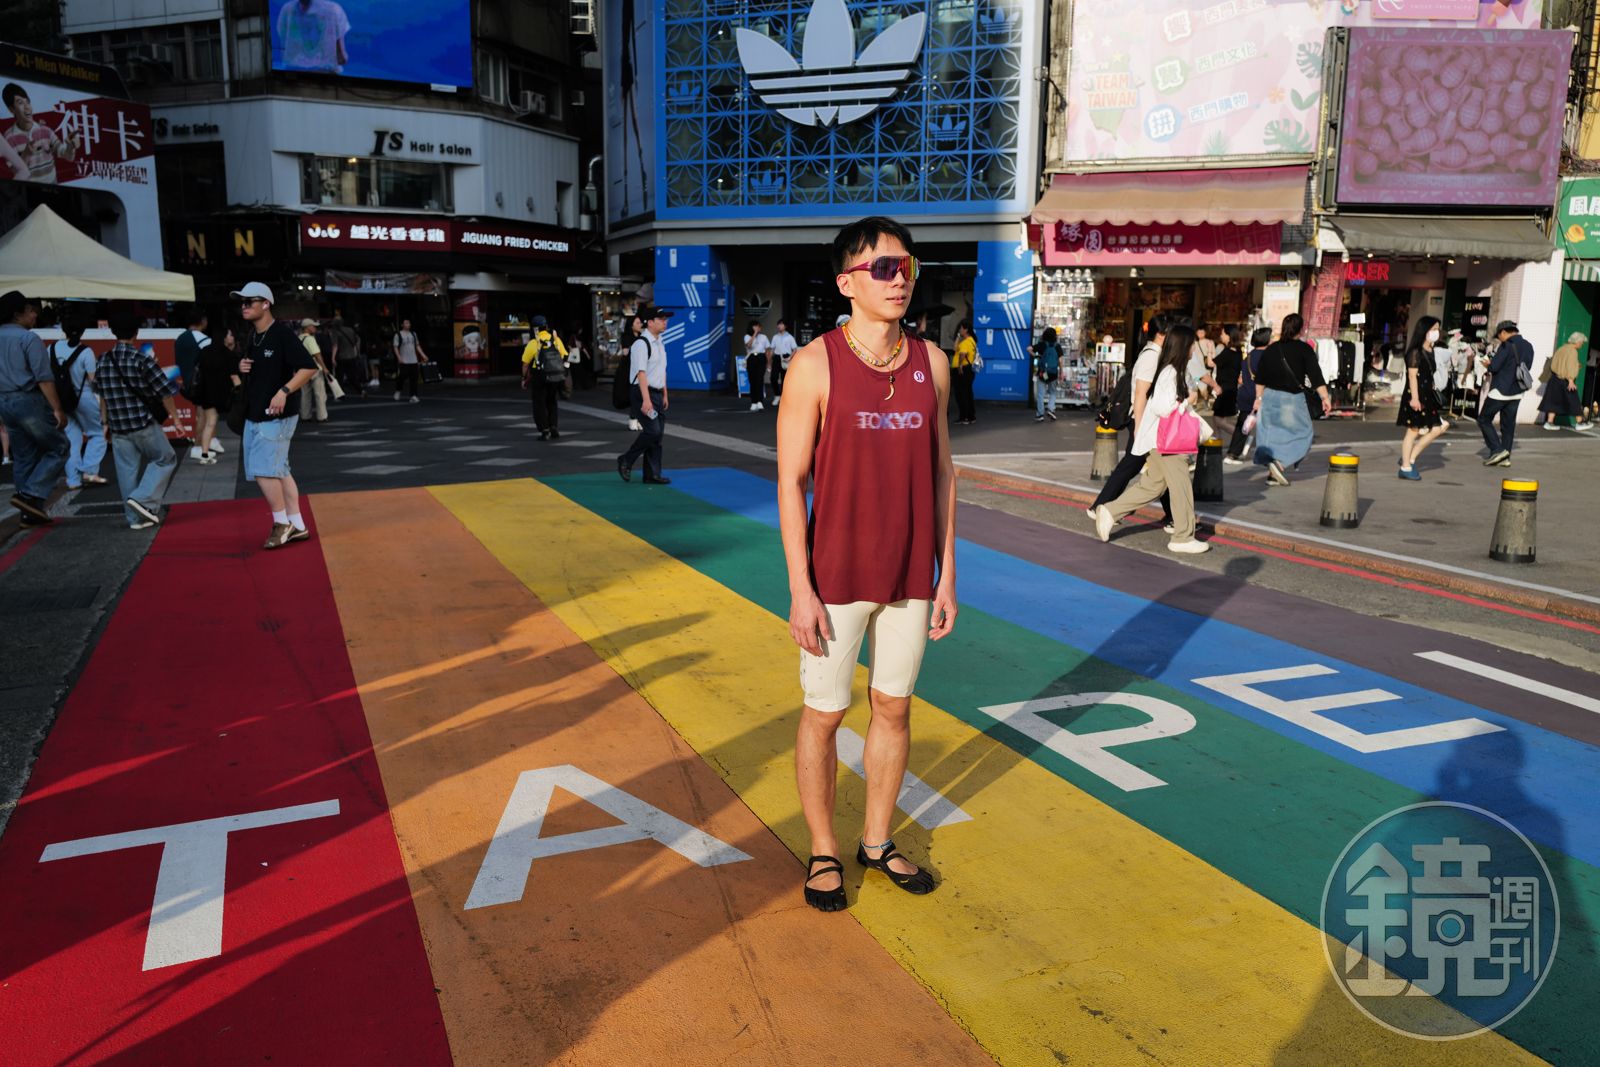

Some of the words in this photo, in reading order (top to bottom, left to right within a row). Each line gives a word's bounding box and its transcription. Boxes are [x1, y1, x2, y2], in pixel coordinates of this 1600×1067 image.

[1095, 73, 1129, 89] TEAM
[1087, 90, 1137, 109] TAIWAN
[53, 100, 145, 161] 神卡
[410, 141, 434, 153] Hair
[440, 143, 472, 156] Salon
[461, 232, 502, 246] JIGUANG
[504, 236, 531, 249] FRIED
[532, 239, 569, 252] CHICKEN
[855, 411, 923, 430] TOKYO
